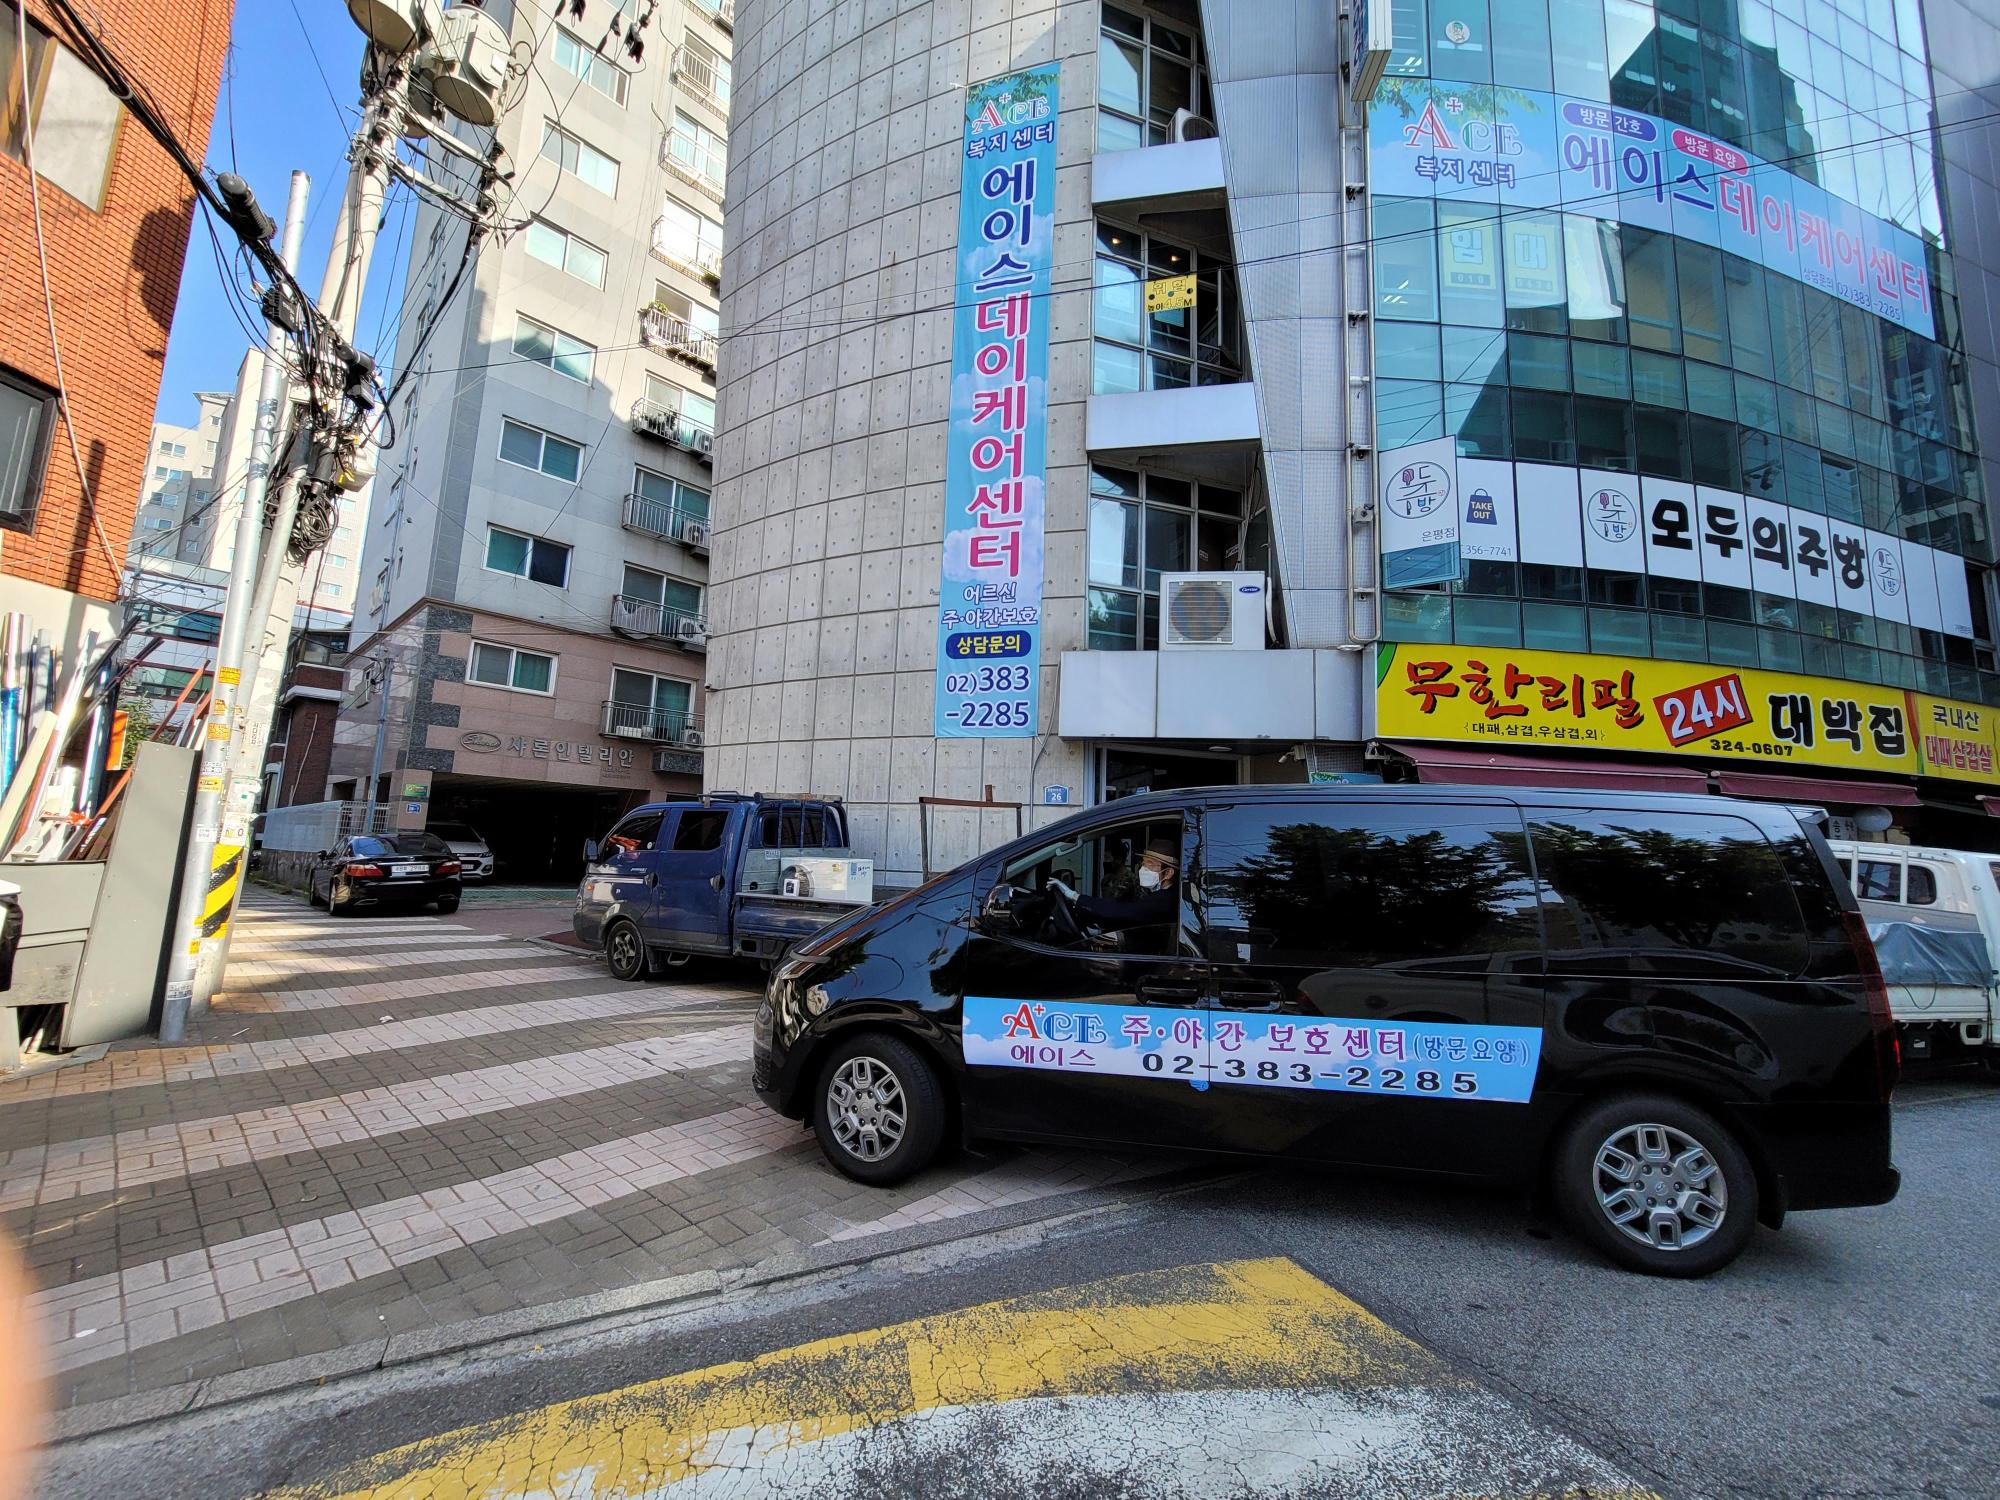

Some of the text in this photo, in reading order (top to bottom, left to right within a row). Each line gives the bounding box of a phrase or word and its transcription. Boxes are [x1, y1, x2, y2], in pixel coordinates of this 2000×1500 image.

[1580, 108, 1642, 134] 방문 간호
[1684, 135, 1737, 168] 방문 요양
[1471, 501, 1493, 510] TAKE
[1473, 511, 1490, 519] OUT
[1421, 527, 1455, 542] 은평점
[1651, 498, 1865, 589] 모두의주방
[963, 583, 1016, 604] 어르신
[956, 634, 1020, 655] 상담문의
[946, 666, 1030, 693] 02)383
[1405, 660, 1645, 729] 무한리필
[946, 702, 1030, 728] -2285
[1663, 680, 1746, 740] 24시
[1933, 705, 1980, 732] 국내산
[1768, 694, 1906, 756] 대박집
[1710, 738, 1792, 757] 324-0607
[1925, 735, 1992, 774] 대패삼겹살
[1051, 793, 1062, 801] 26
[1010, 1044, 1096, 1067] 에이스
[1142, 1053, 1478, 1094] 02-383-2285
